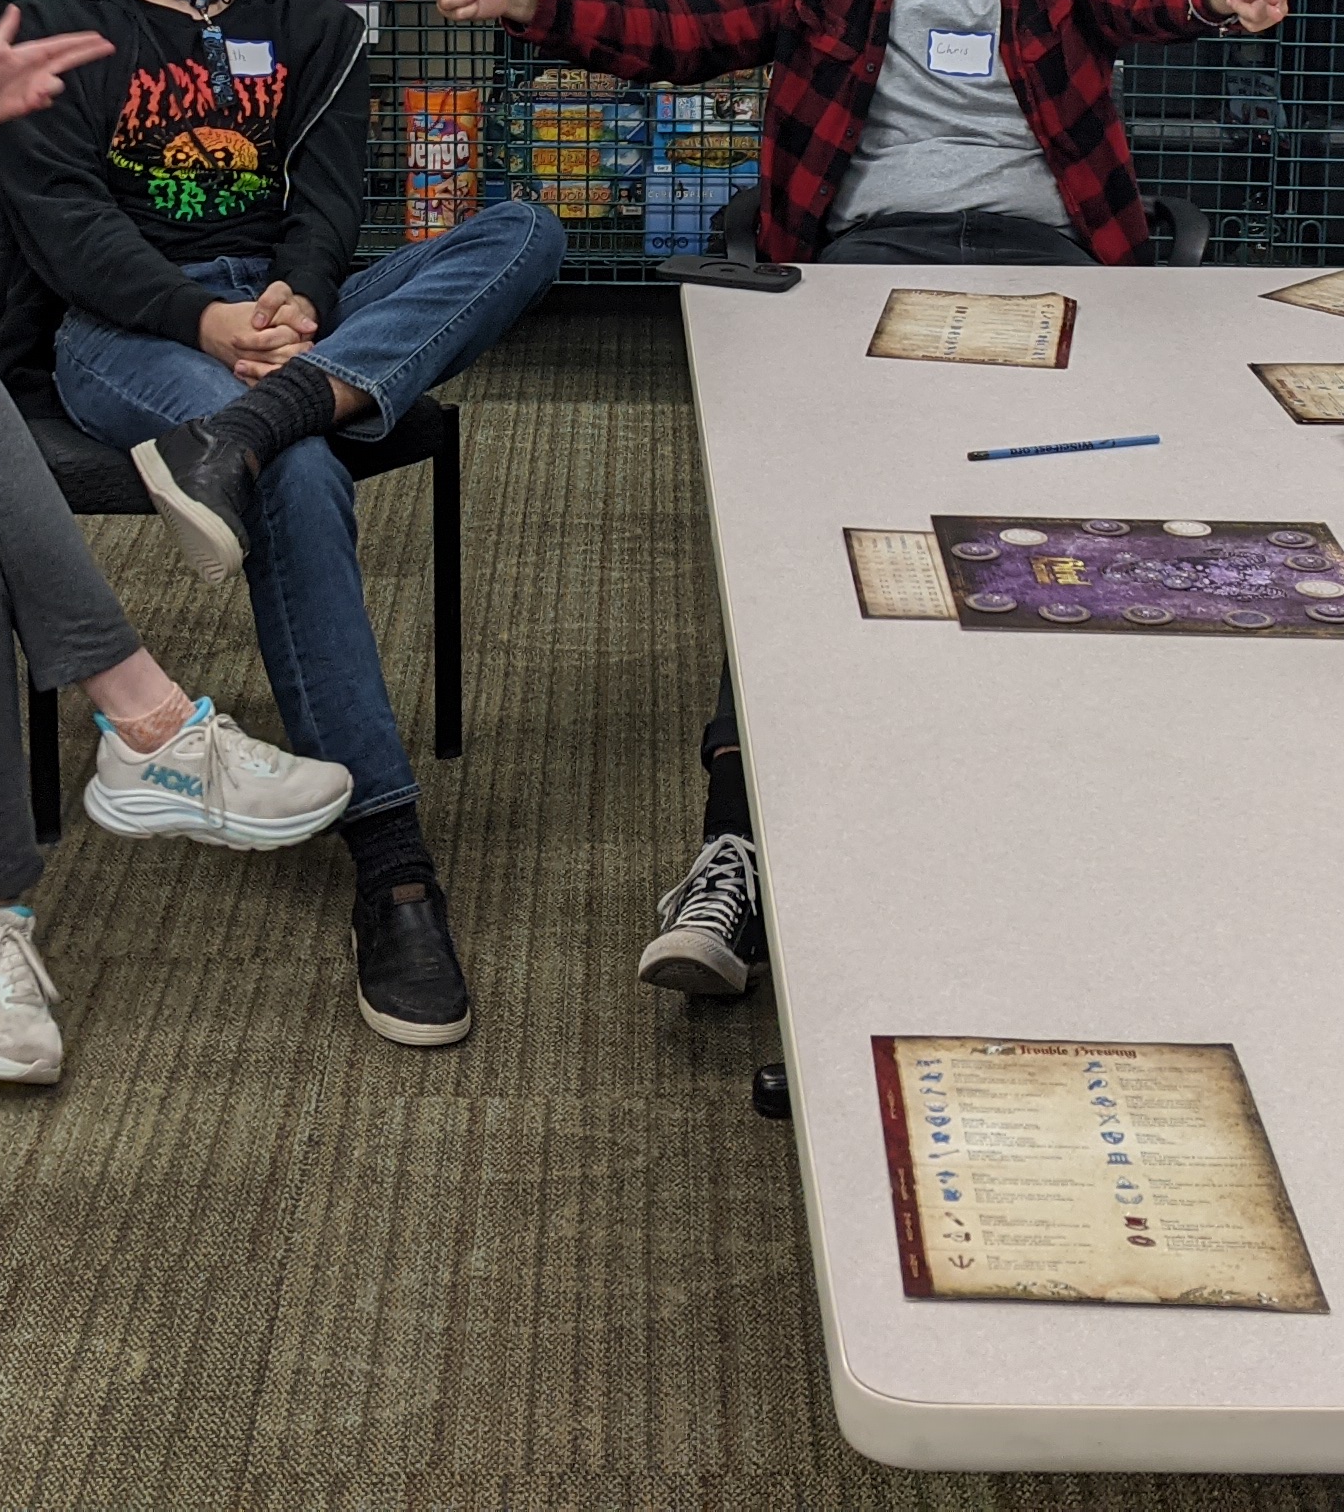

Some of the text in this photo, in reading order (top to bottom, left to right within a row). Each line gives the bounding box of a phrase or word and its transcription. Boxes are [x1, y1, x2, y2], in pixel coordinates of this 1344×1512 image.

[936, 42, 969, 56] Chris
[407, 130, 470, 170] Jenga
[1019, 1044, 1138, 1059] Trouble Brewing
